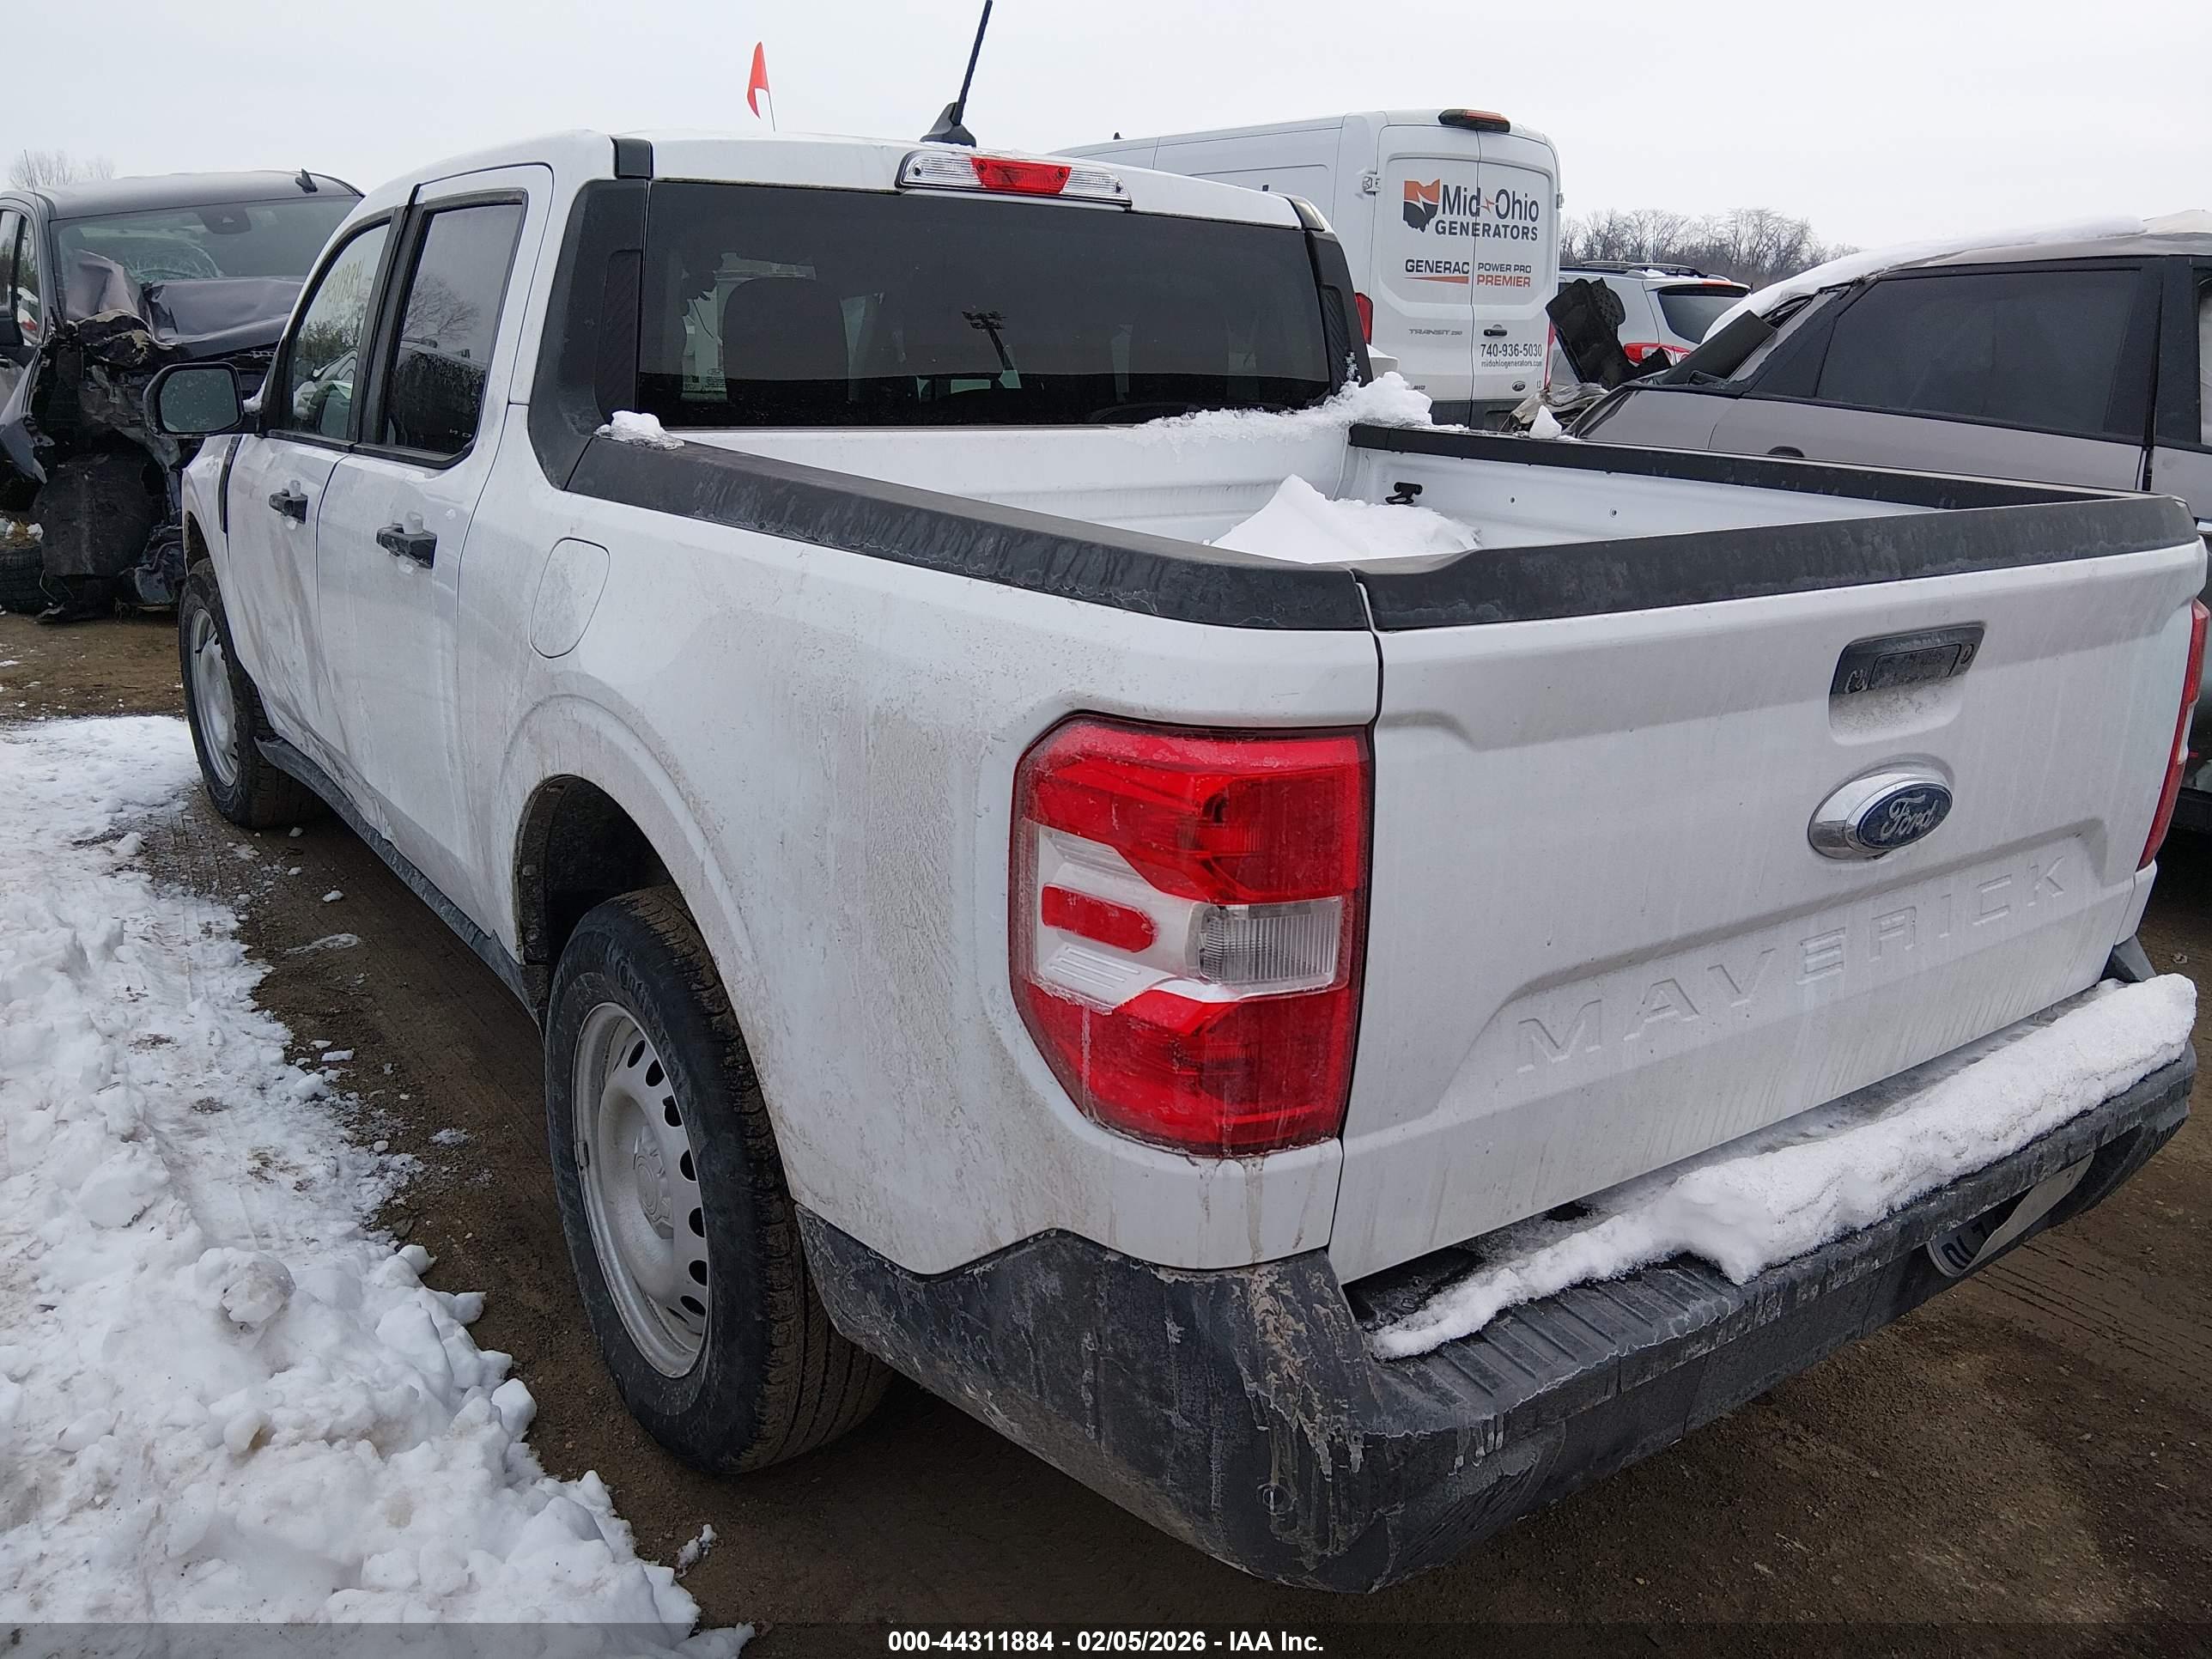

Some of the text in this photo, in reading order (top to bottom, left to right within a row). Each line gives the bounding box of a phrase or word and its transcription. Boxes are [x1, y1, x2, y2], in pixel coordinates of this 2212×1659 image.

[1443, 185, 1540, 222] Mid Ohio
[1435, 220, 1538, 241] GENERATORS
[1405, 258, 1470, 275] GENERAC
[1478, 262, 1532, 273] POWER PRO
[1476, 274, 1531, 288] PREMIER
[1480, 343, 1542, 357] 740-936-5030
[1880, 794, 1938, 842] Ford
[1516, 857, 2065, 1073] MAVERICK
